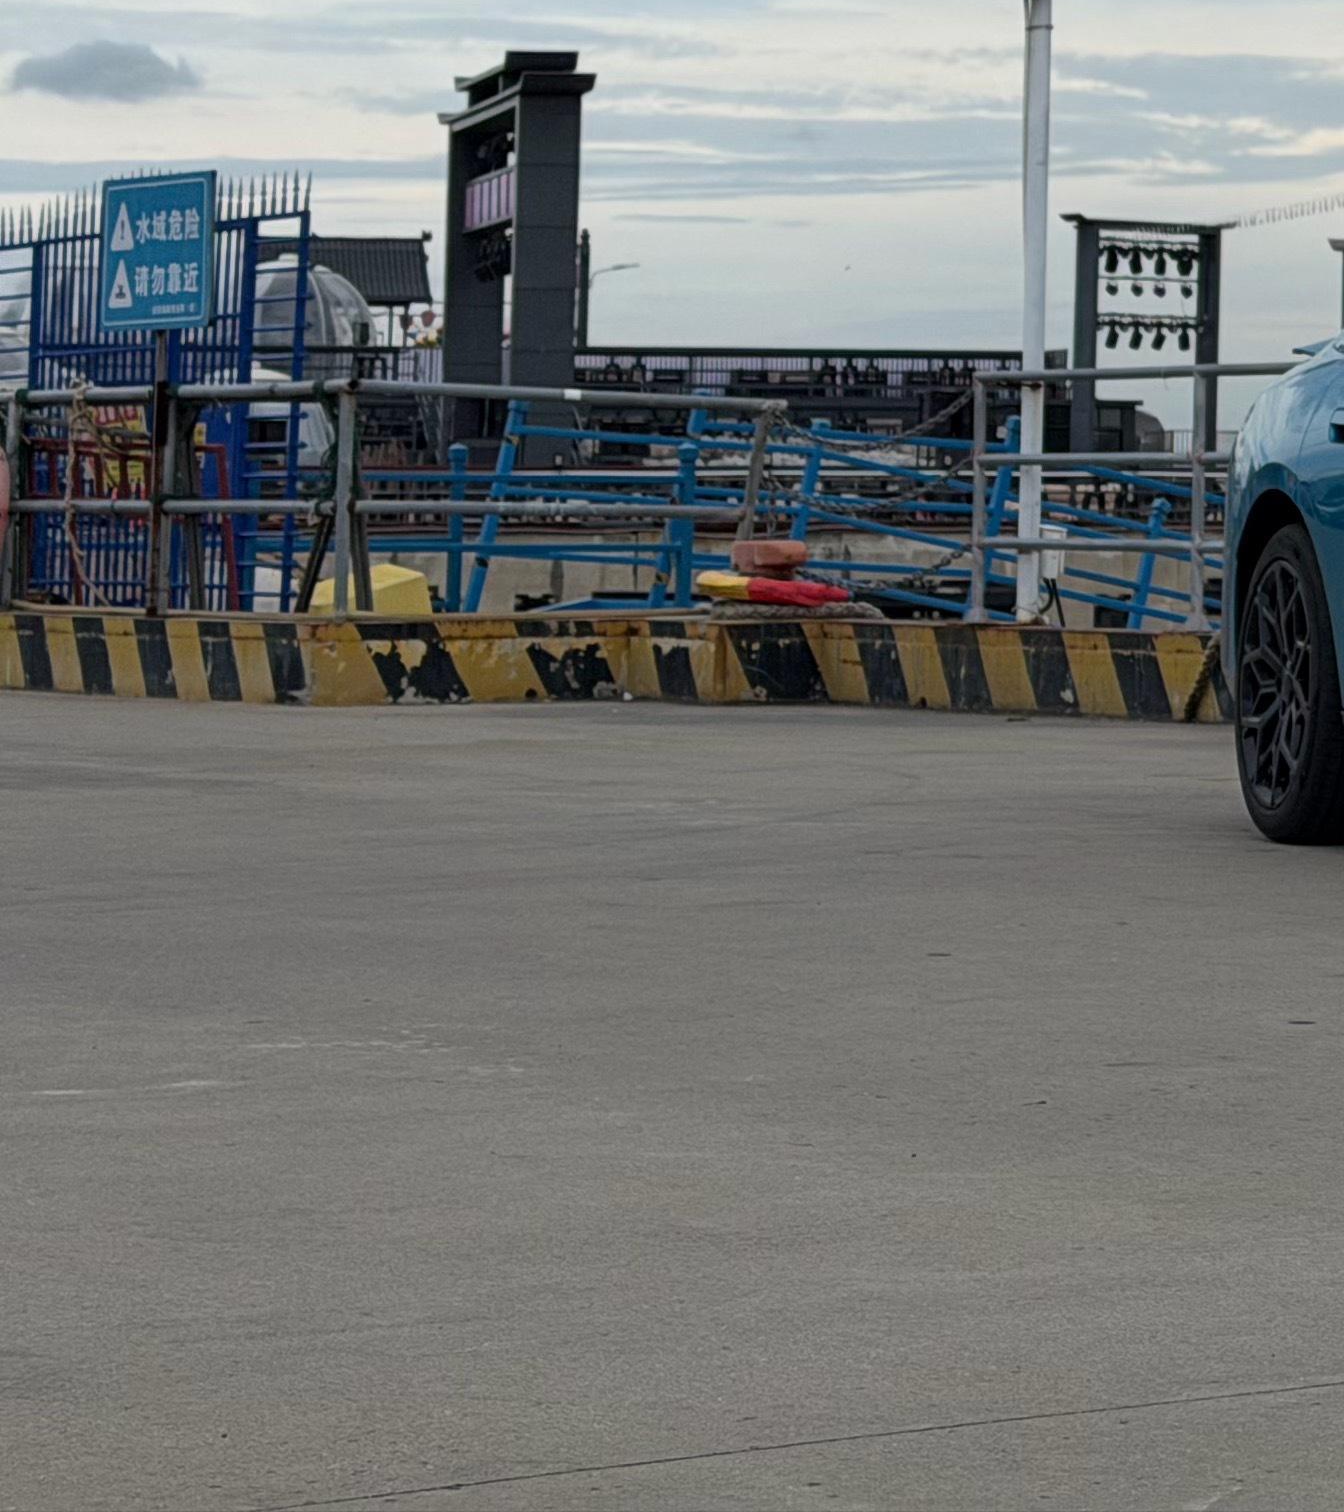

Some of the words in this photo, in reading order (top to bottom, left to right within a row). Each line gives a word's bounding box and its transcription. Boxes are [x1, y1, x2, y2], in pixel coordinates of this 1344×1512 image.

[135, 207, 200, 244] 水域危险
[134, 262, 199, 297] 请勿靠近
